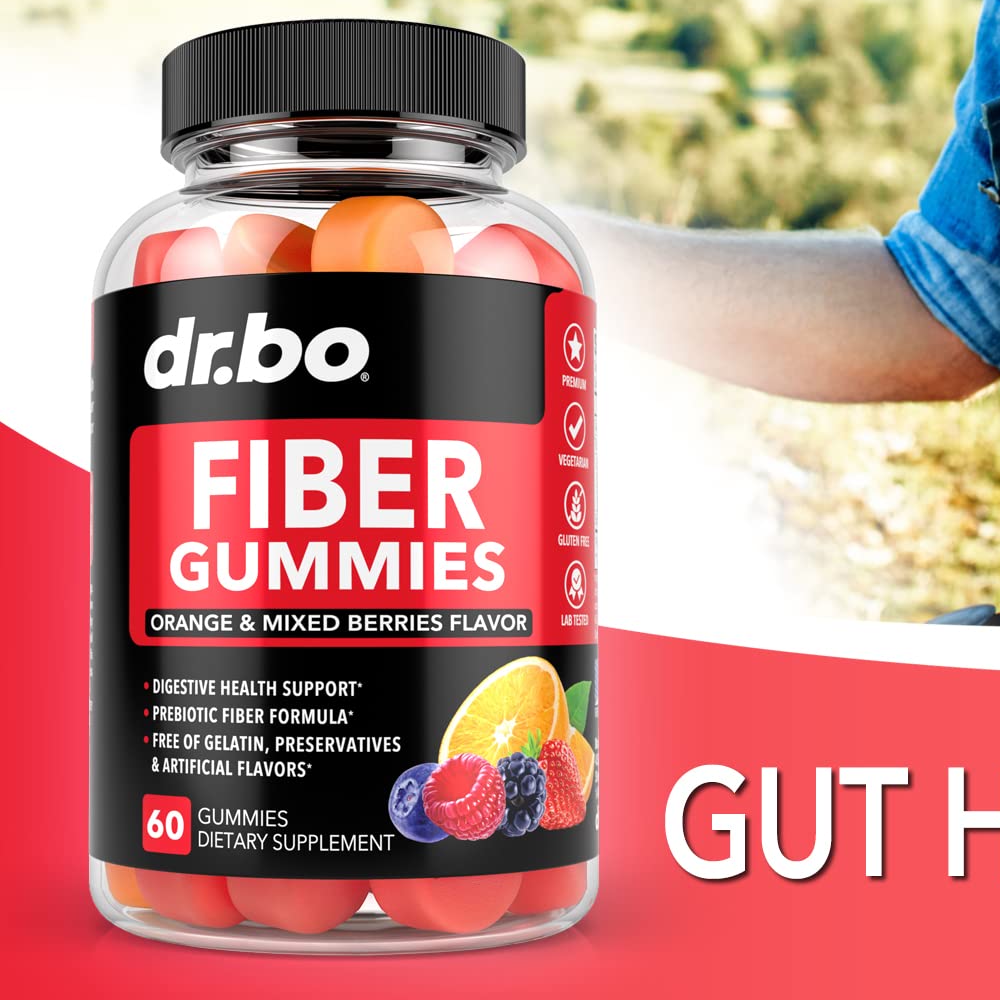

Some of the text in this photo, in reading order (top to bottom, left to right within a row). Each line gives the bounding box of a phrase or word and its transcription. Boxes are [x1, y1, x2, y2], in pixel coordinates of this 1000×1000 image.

[563, 375, 586, 389] PREMIUM
[559, 455, 588, 468] VEGETARIAN
[194, 439, 485, 529] FIBER
[558, 535, 590, 547] GLUTEN FREE
[170, 541, 505, 591] GUMMIES
[151, 614, 526, 631] ORANGE & MIXED BERRIES FLAVOR
[562, 615, 588, 625] LAB TESTED
[154, 679, 215, 695] DIGESTIVE
[221, 680, 276, 696] HEALTH
[153, 706, 217, 723] PREBIOTIC
[223, 708, 263, 723] FIBER
[153, 733, 400, 753] FREE OF GELATIN, PRESERVATIVES
[152, 757, 159, 772] &
[163, 758, 232, 775] ARTIFICIAL
[147, 810, 184, 840] 60
[198, 808, 287, 827] GUMMIES
[199, 831, 394, 851] DIETARY SUPPLEMENT
